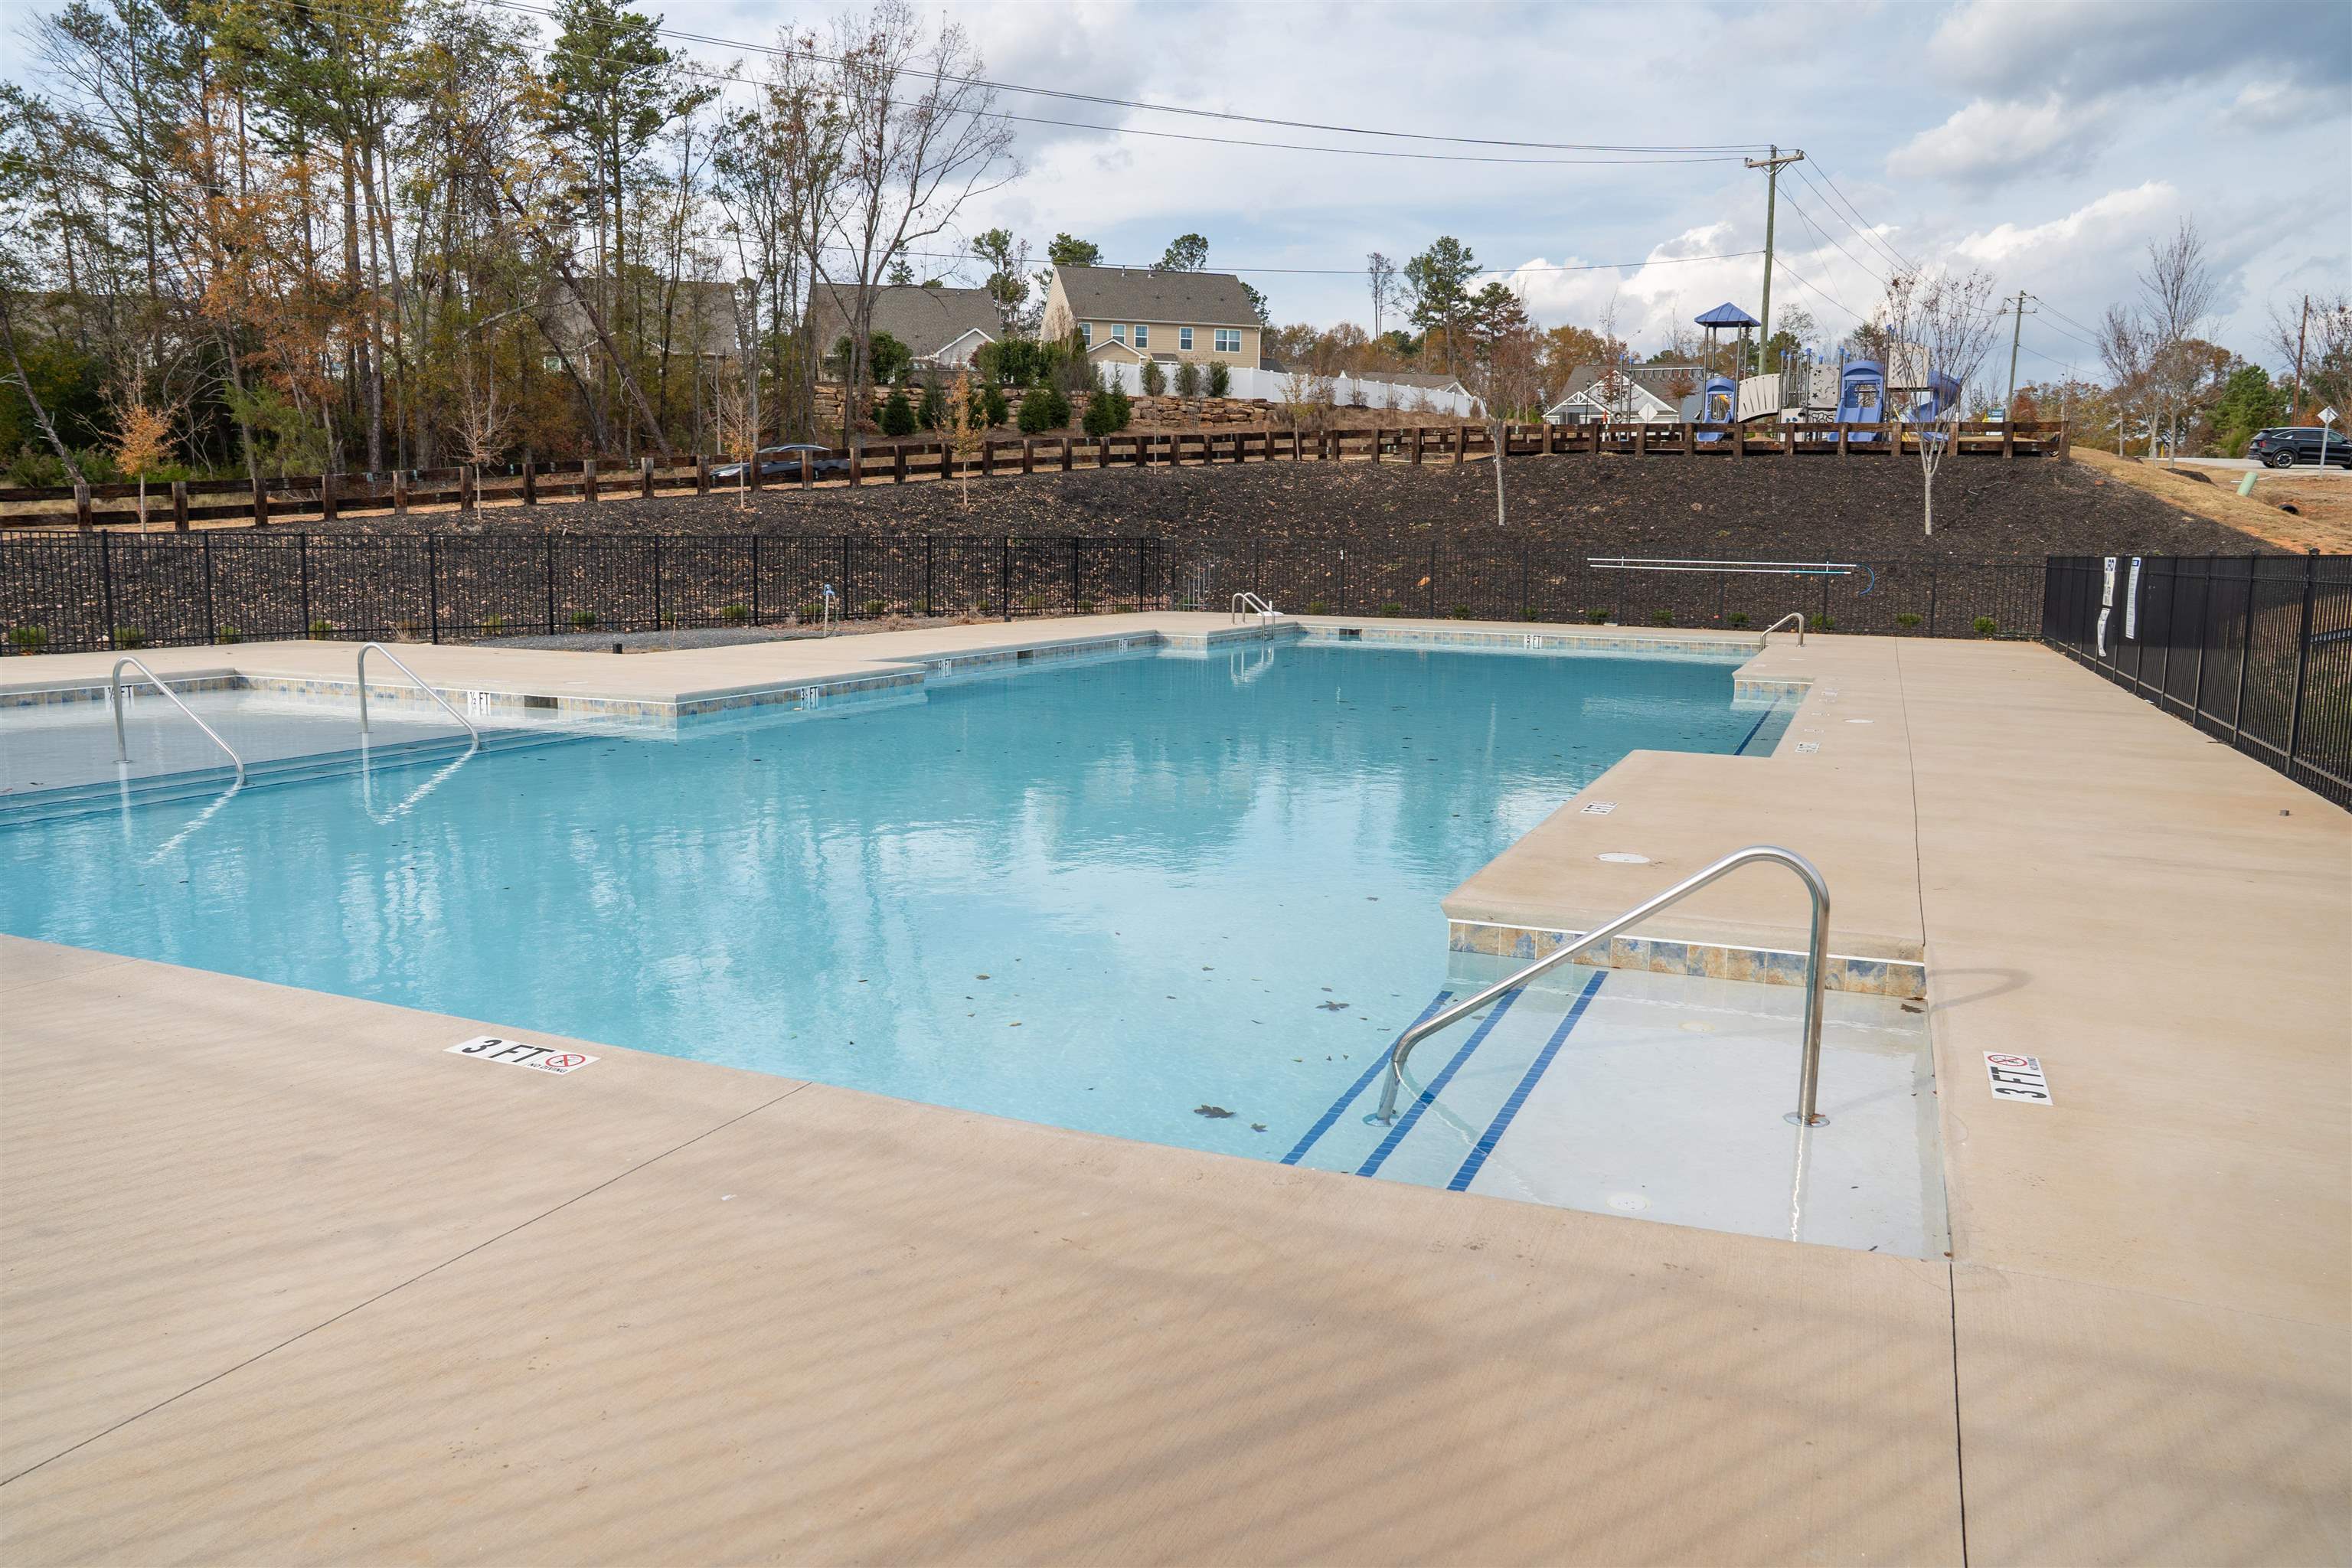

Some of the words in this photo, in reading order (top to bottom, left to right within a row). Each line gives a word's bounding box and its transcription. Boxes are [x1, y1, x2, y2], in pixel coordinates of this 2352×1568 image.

[479, 691, 489, 705] FT
[809, 686, 818, 698] FT
[462, 1039, 502, 1054] 3
[488, 1044, 556, 1063] FT
[1990, 1066, 2044, 1087] FT
[1994, 1087, 2047, 1099] 3
